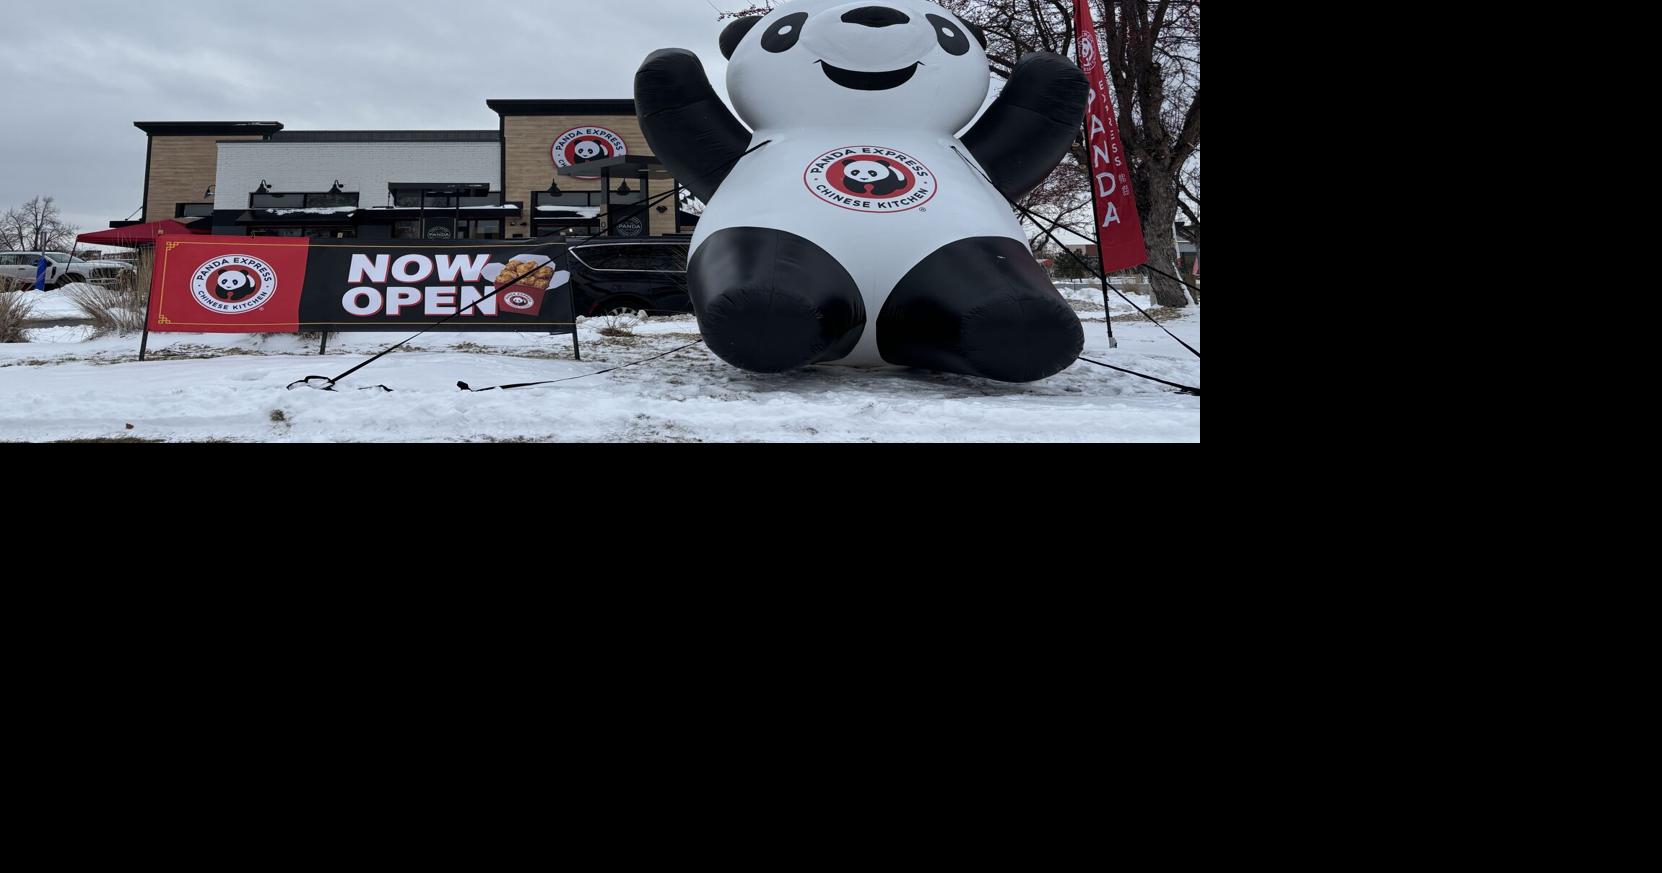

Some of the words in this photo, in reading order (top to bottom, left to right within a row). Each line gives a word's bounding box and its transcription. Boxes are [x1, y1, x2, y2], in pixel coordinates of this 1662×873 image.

[555, 130, 583, 150] PANDA
[586, 128, 623, 151] EXPRESS
[810, 149, 857, 174] PANDA
[862, 147, 929, 177] EXPRESS
[1087, 88, 1120, 227] PANDA
[816, 184, 871, 208] CHINESE
[877, 187, 929, 209] KITCHEN
[196, 258, 230, 281] PANDA
[233, 257, 272, 282] EXPRESS
[347, 253, 493, 283] NOW
[198, 290, 229, 310] CHINESE
[232, 291, 268, 310] KITCHEN
[341, 285, 498, 316] OPEN
